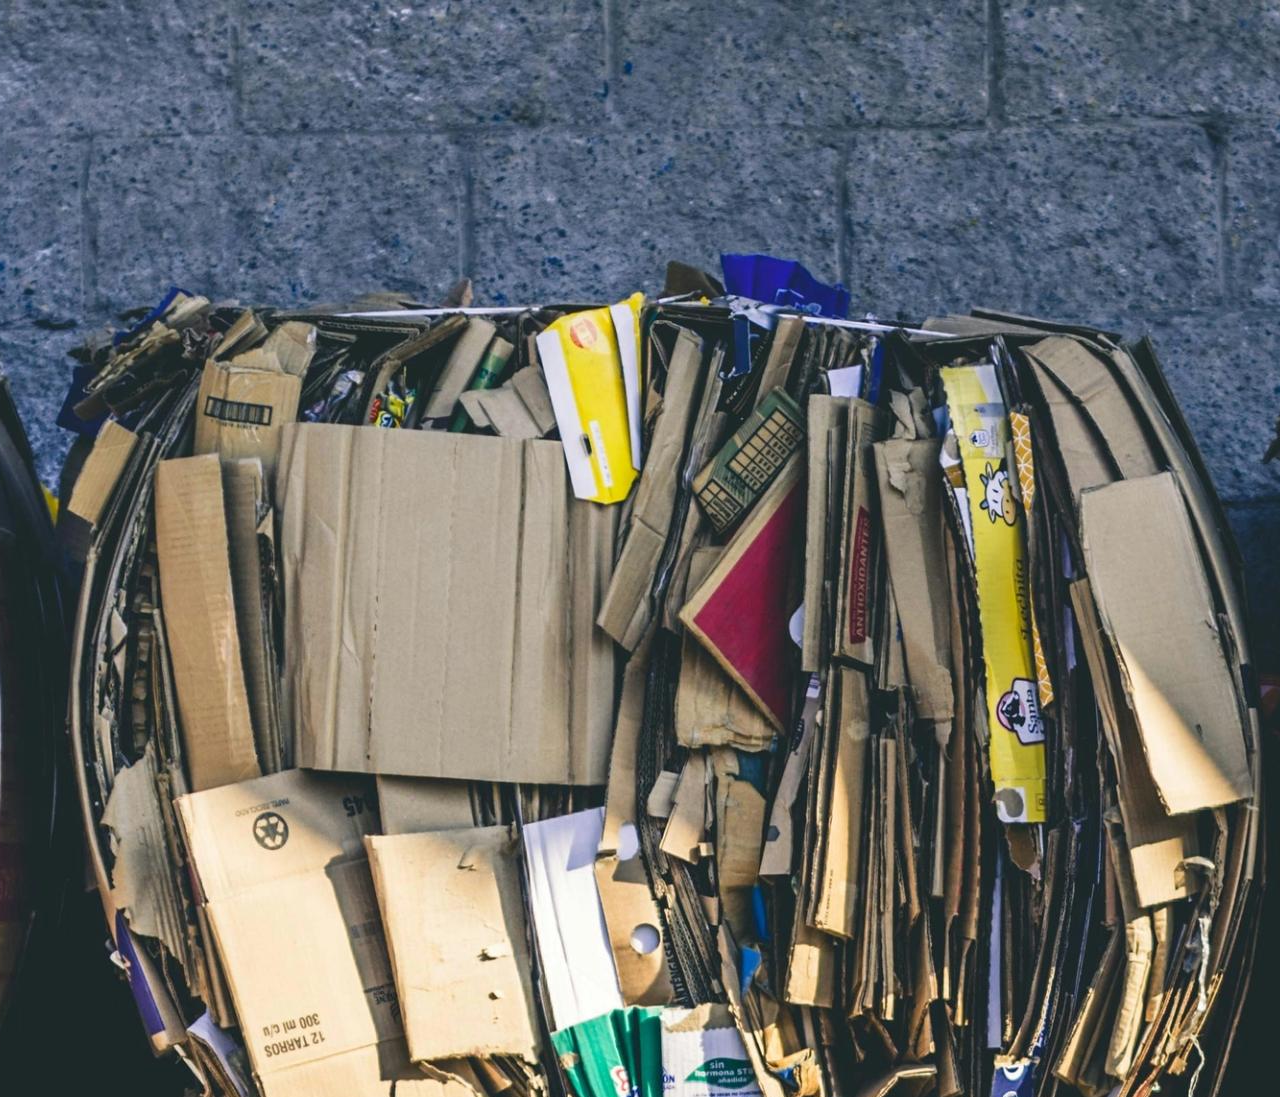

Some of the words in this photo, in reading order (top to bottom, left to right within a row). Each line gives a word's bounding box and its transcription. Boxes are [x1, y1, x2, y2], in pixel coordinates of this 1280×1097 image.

[298, 1012, 320, 1028] 300
[311, 1032, 326, 1044] 12
[265, 1038, 310, 1058] TARROS
[710, 1061, 724, 1069] sin
